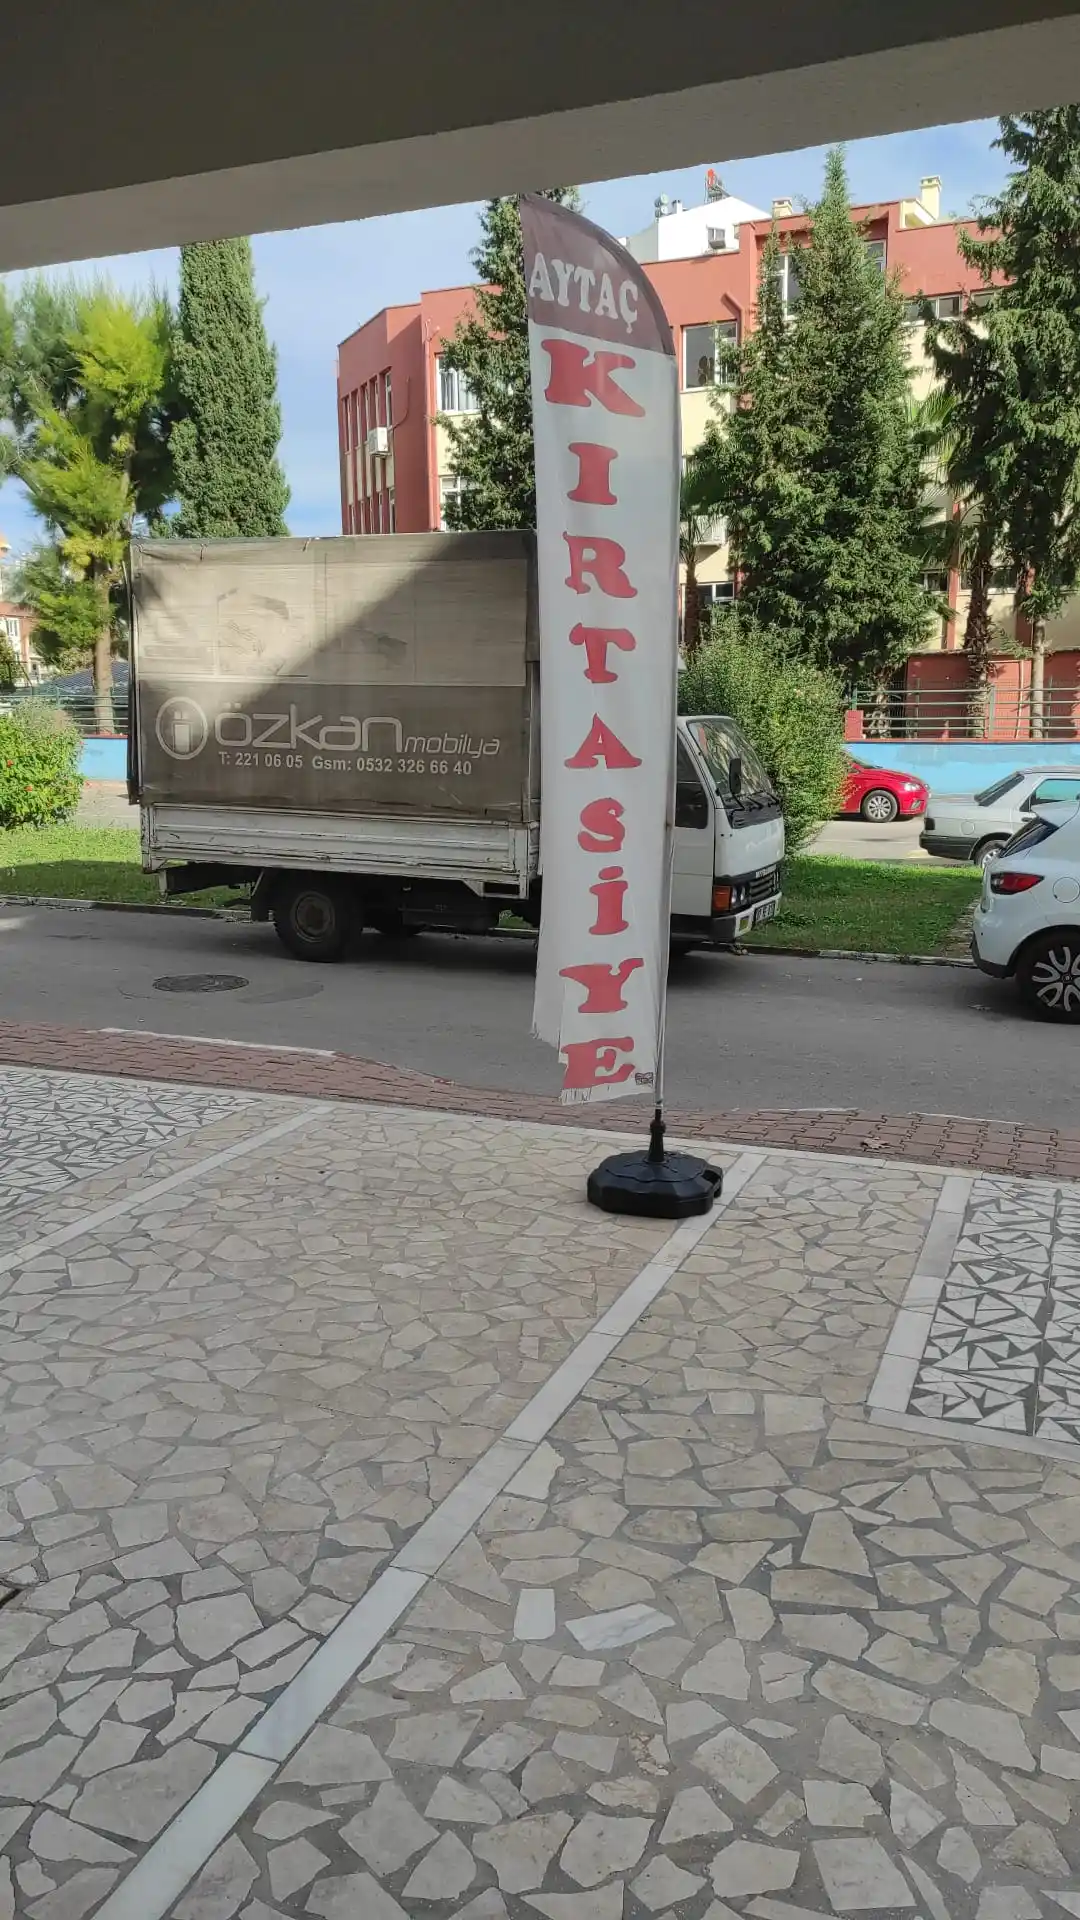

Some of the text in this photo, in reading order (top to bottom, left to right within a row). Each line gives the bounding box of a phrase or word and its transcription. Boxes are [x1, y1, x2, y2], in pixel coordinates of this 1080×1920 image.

[529, 252, 638, 334] AYTAÇ
[404, 732, 501, 759] mobilya
[218, 751, 472, 776] T: 221 06 05 Gsm: 0532 326 66 40
